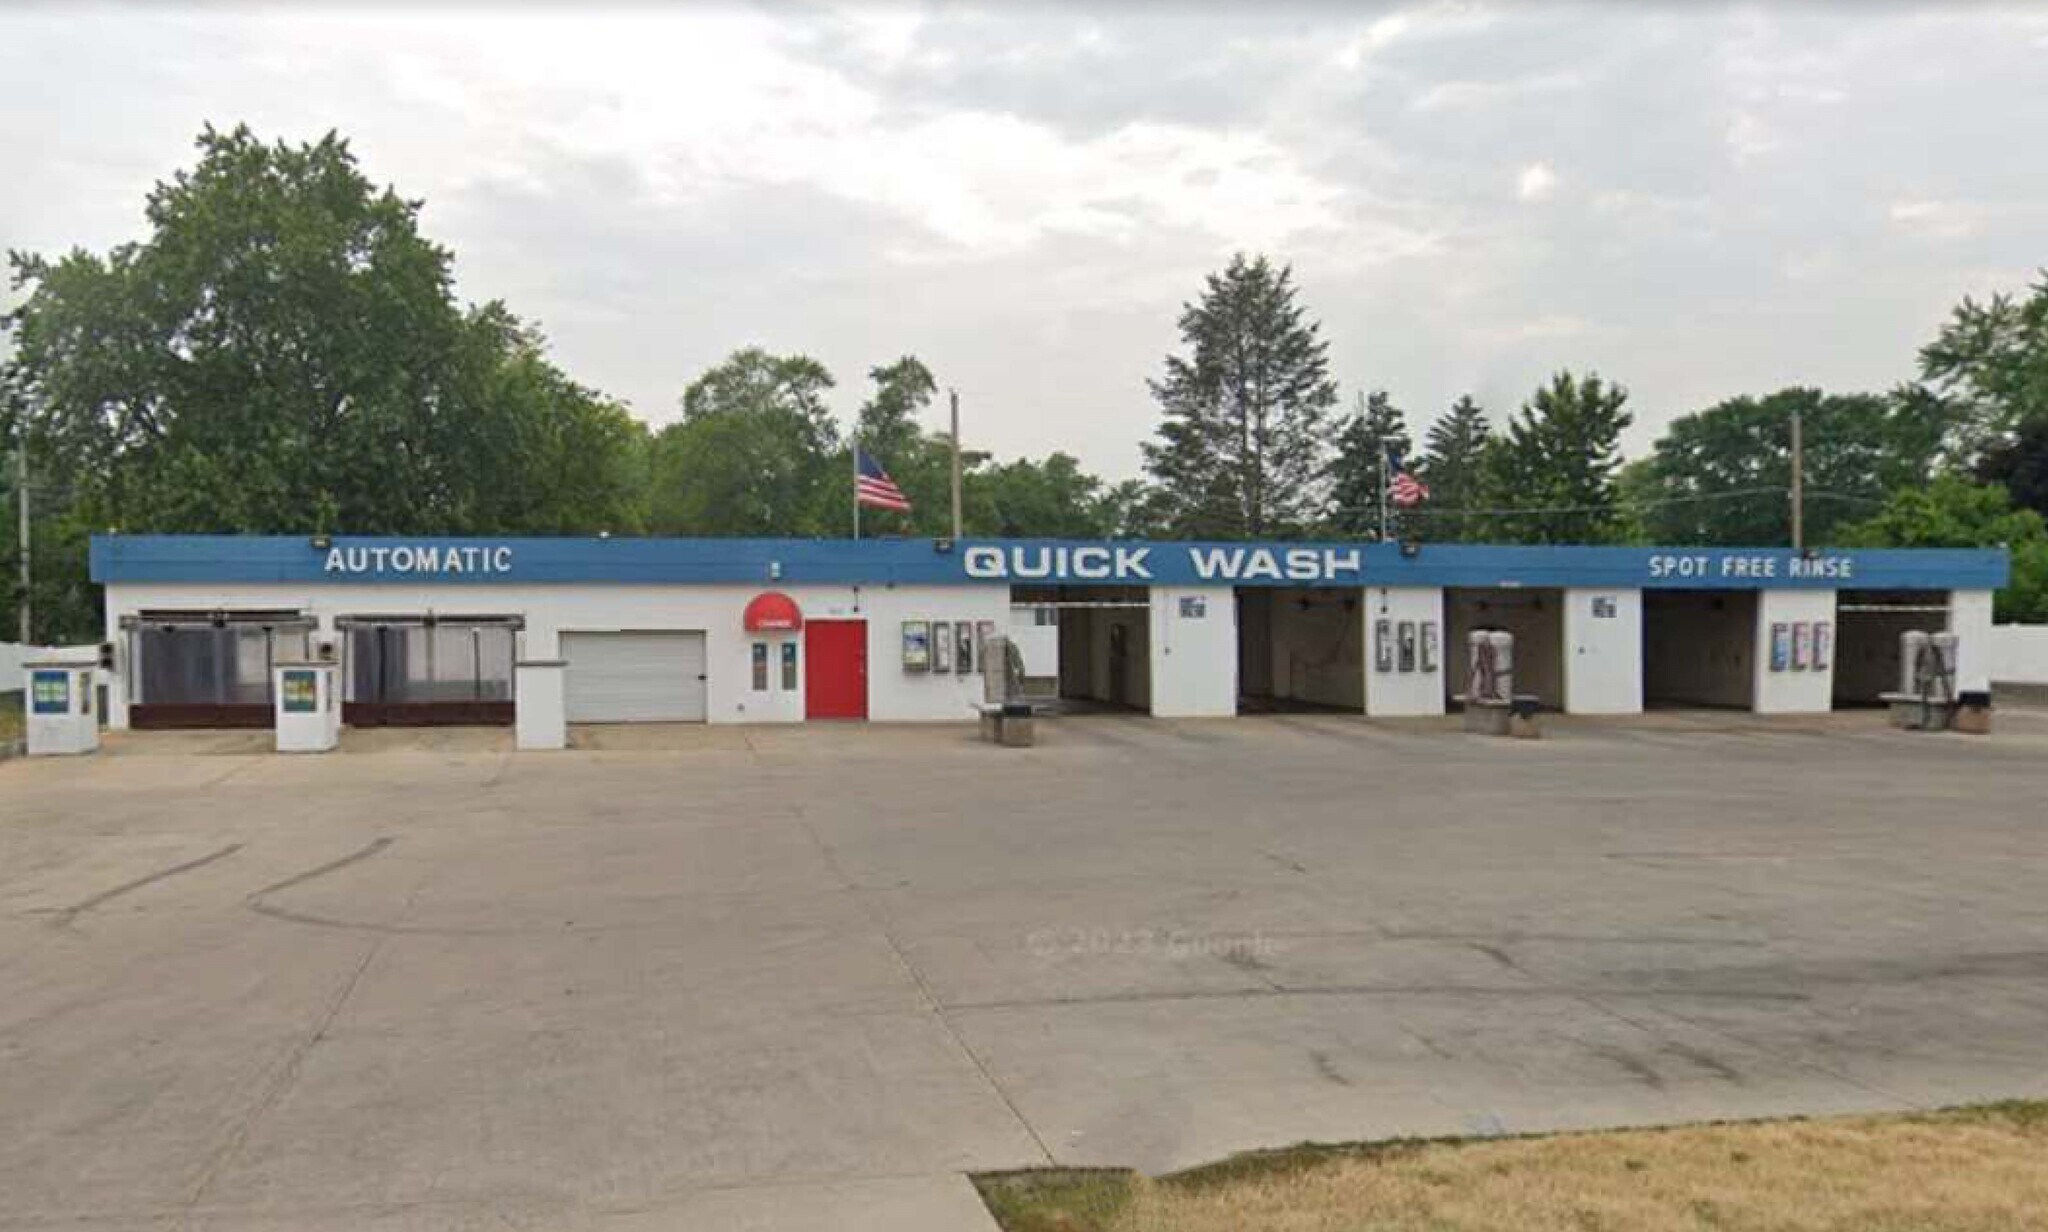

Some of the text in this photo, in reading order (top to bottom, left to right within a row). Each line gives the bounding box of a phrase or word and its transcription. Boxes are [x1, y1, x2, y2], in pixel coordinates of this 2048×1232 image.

[324, 547, 513, 572] AUTOMATIC
[964, 547, 1361, 579] QUICK WASH
[1649, 556, 1851, 577] SPOT FREE RINSE
